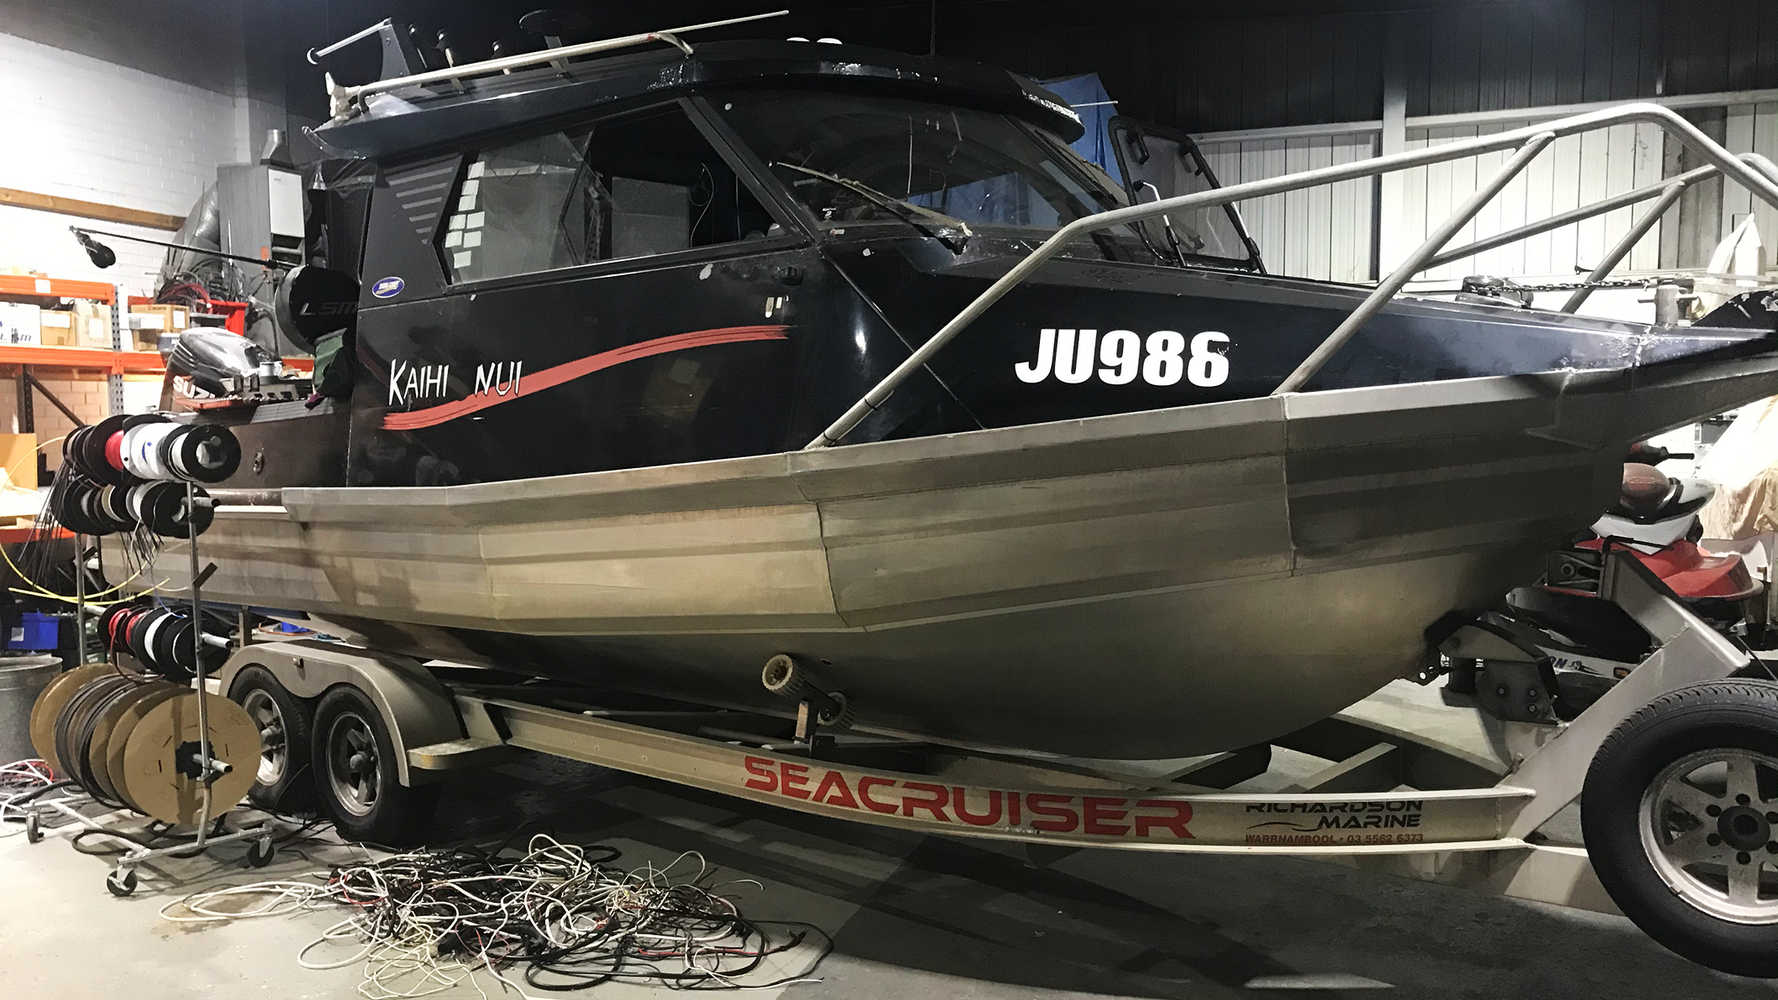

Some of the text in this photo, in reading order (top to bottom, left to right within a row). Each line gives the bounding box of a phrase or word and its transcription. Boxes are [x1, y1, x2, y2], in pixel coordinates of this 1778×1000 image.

[1014, 328, 1231, 388] JU986
[173, 375, 217, 399] SUZ
[388, 358, 523, 406] KAIHI NUI
[744, 755, 1197, 839] SEACRUISER
[1246, 800, 1424, 813] RICHARDSON
[1318, 814, 1422, 829] MARINE
